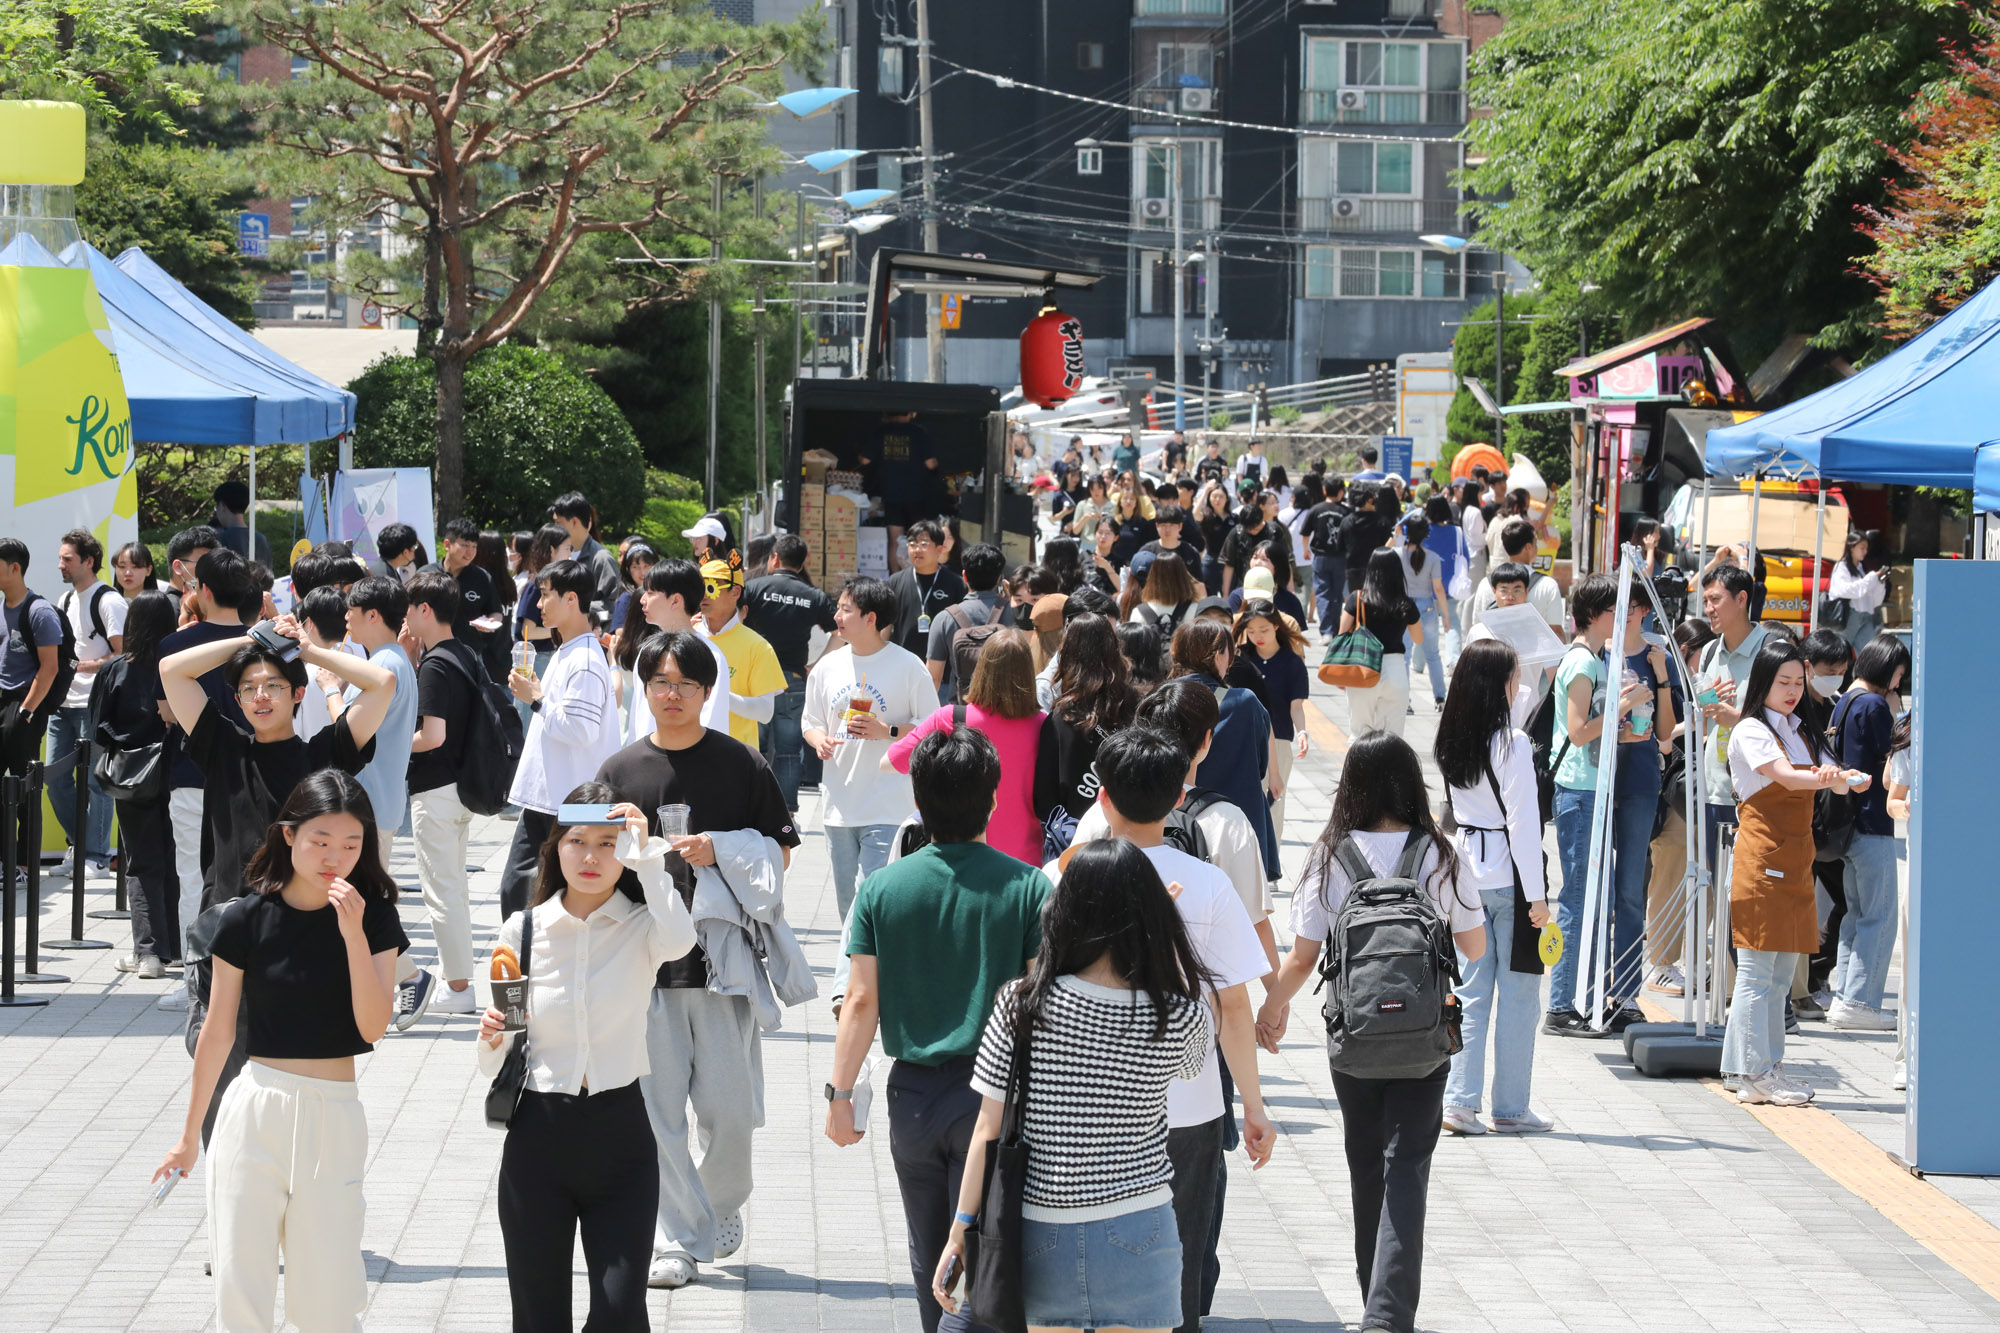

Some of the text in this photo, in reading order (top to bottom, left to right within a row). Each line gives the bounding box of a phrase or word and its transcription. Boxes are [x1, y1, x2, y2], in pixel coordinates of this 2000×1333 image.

[763, 592, 811, 609] LENS ME
[831, 684, 851, 710] NJOY
